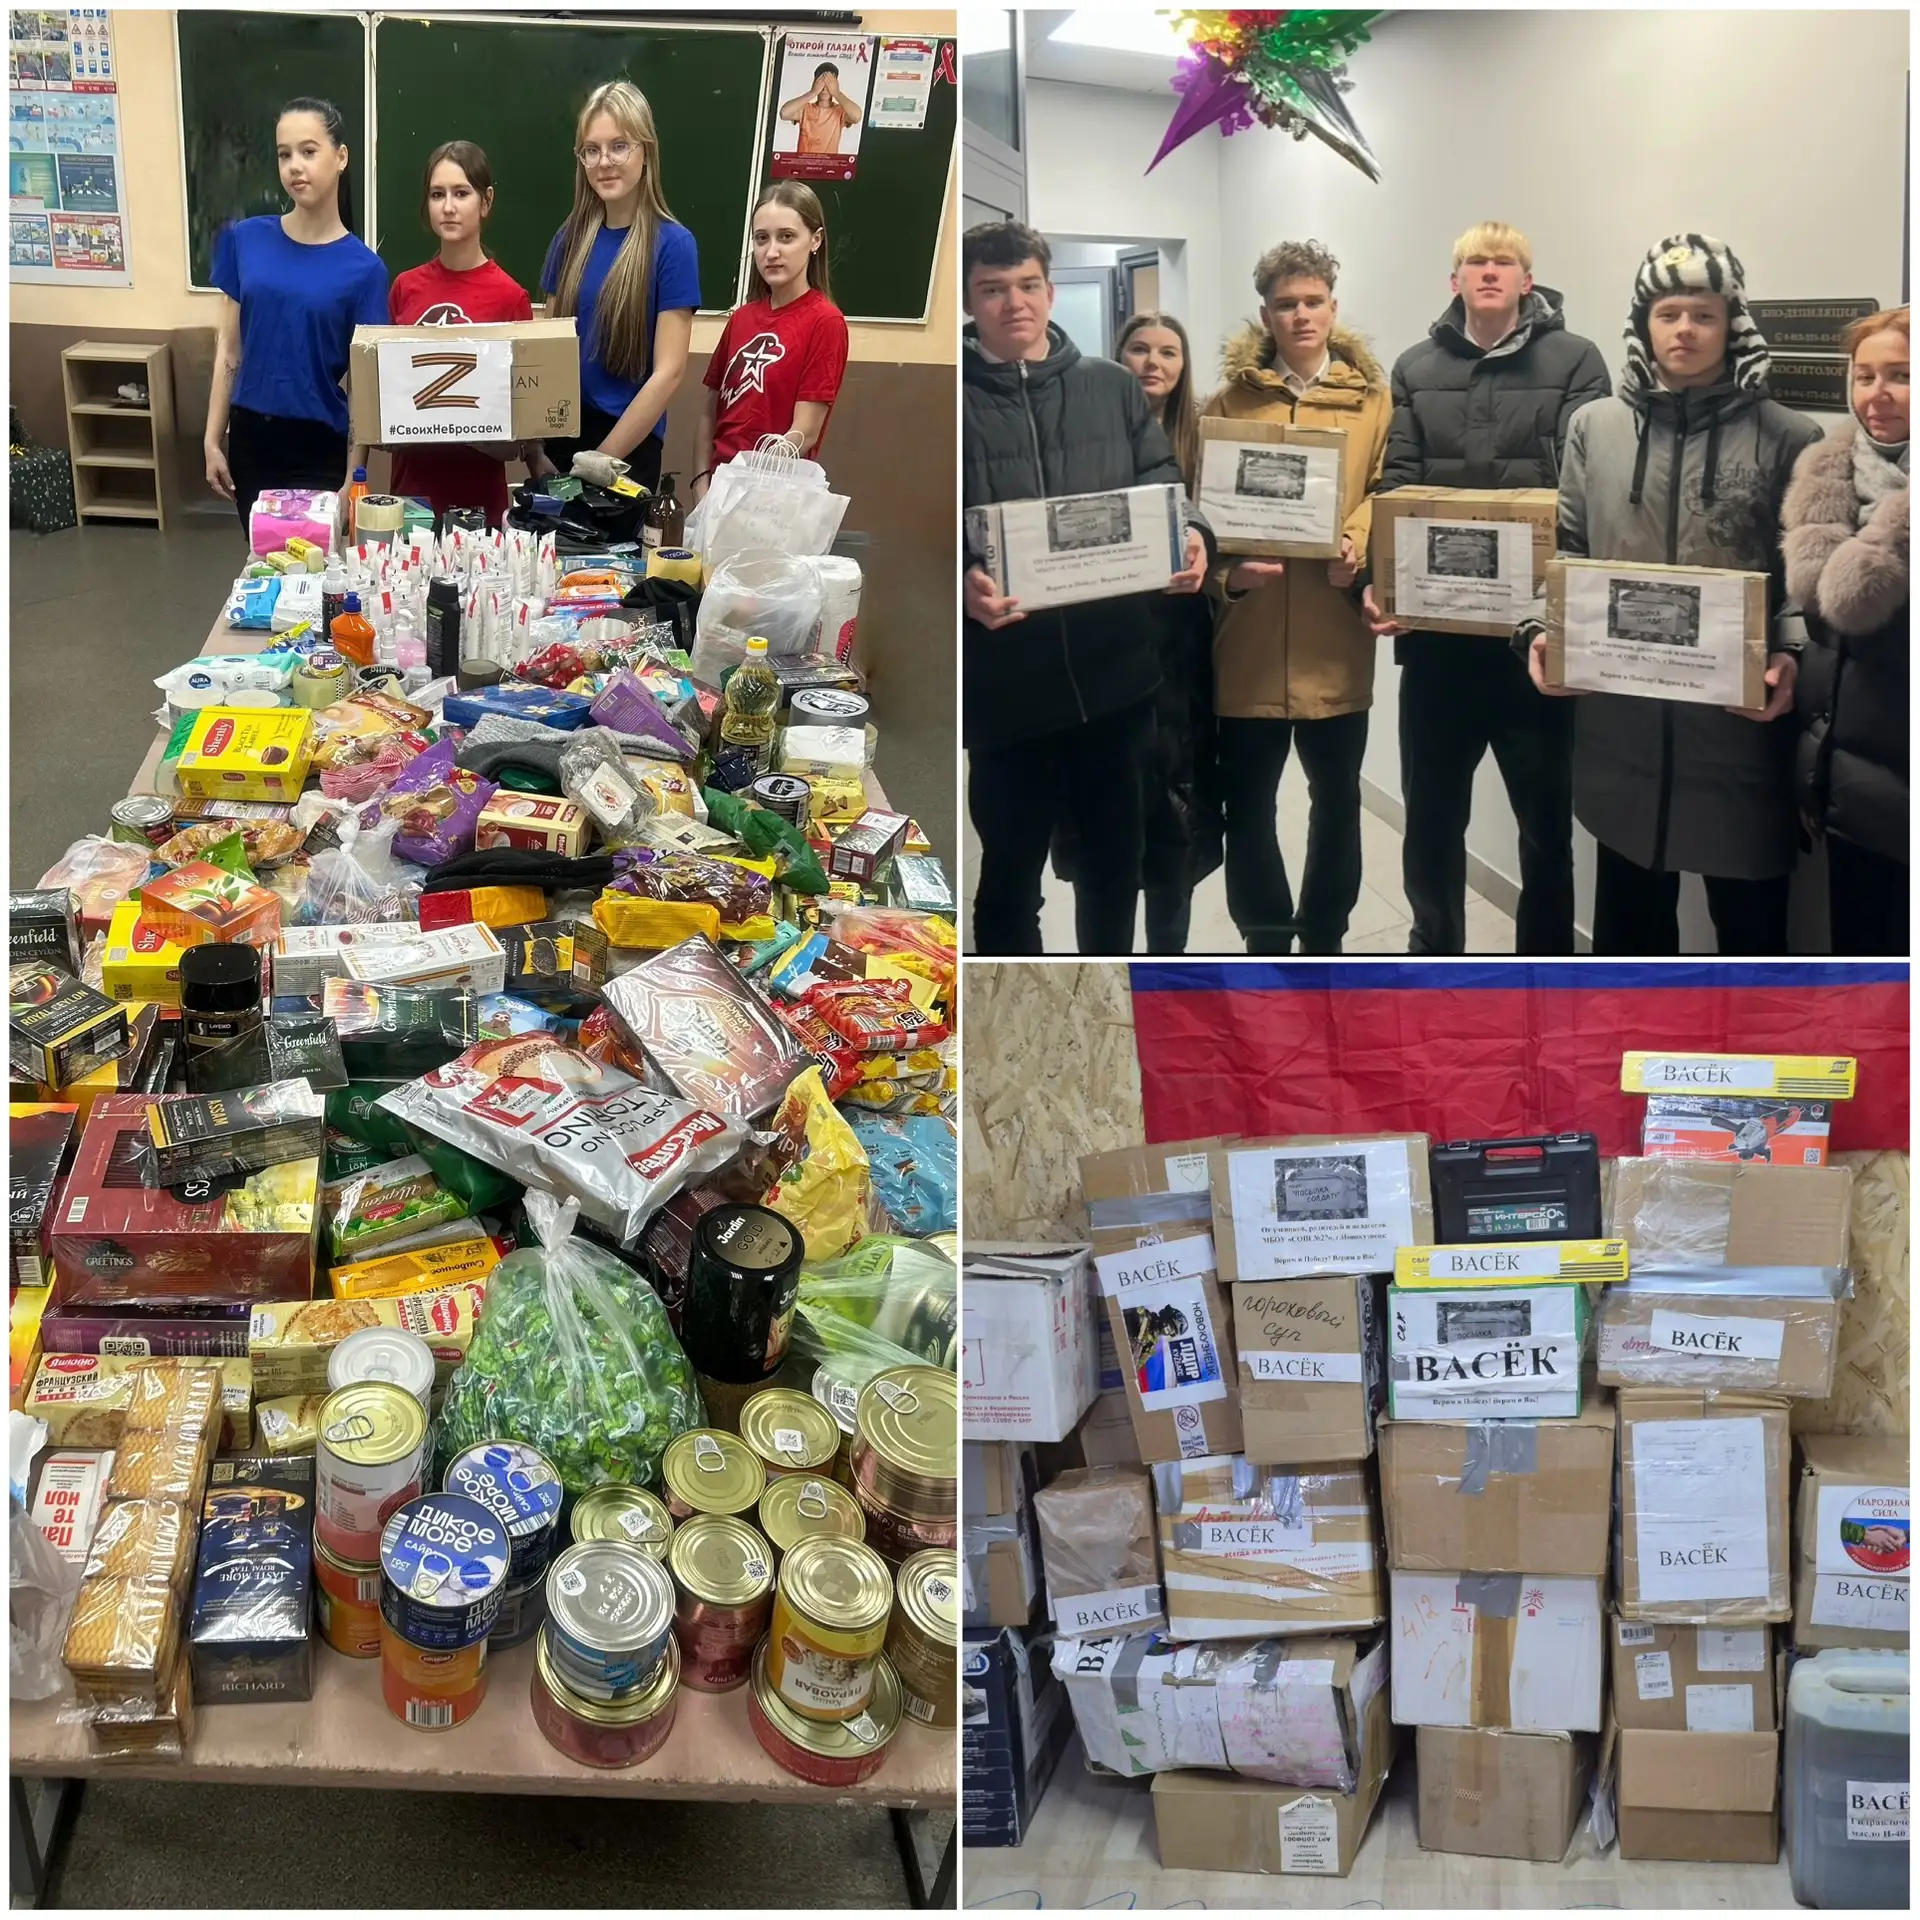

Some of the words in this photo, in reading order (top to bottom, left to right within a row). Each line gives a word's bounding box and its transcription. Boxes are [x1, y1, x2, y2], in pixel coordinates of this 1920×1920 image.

[789, 40, 825, 51] ОТКРОЙ
[827, 43, 856, 52] ГЛАЗА!
[1772, 365, 1845, 377] КОСМЕТОЛОГ
[411, 353, 480, 410] Z
[545, 416, 556, 424] 100
[389, 424, 503, 437] #СвоихНеБросаем
[205, 722, 232, 754] Shenly
[28, 948, 61, 956] CEYLON
[20, 1008, 55, 1027] ROYAL
[52, 989, 89, 1011] CEYLON
[382, 988, 397, 1032] Greenfield
[721, 995, 752, 1034] ХАРАКТЕ
[283, 1031, 327, 1051] Greenfield
[1664, 1064, 1733, 1083] ВАСЁК
[208, 1099, 230, 1127] ASSAM
[633, 1113, 721, 1173] MacCoffee
[1306, 1191, 1340, 1203] СОЛДАТУ"
[1494, 1209, 1564, 1221] ИНТЕРСКОЛ
[717, 1216, 746, 1244] Jardin
[737, 1223, 763, 1251] GOLD
[1261, 1226, 1271, 1234] От
[1263, 1235, 1284, 1244] МБОУ
[86, 1255, 134, 1267] GREETINGS
[431, 1259, 485, 1276] Сливочное
[1274, 1256, 1296, 1265] Верим
[1304, 1253, 1331, 1263] Победу!
[1333, 1254, 1355, 1262] Верим
[1362, 1252, 1377, 1260] Вас!
[1451, 1252, 1520, 1271] ВАСЁК
[1118, 1259, 1182, 1287] ВАСЁК
[1243, 1296, 1345, 1328] гороховый
[1192, 1302, 1217, 1376] НОВОКУЗНЕЦК
[1263, 1322, 1301, 1346] суп
[1671, 1330, 1742, 1352] ВАСЁК
[1180, 1341, 1200, 1379] ЛДПР
[1258, 1357, 1325, 1378] ВАСЁК
[1416, 1342, 1558, 1382] ВАСЁК
[36, 1372, 98, 1388] ФРАНЦУЗСКИЙ
[1433, 1398, 1456, 1407] Верим
[1524, 1396, 1539, 1404] Вас!
[1857, 1498, 1910, 1507] НАРОДНАЯ
[1872, 1508, 1898, 1517] СИЛА
[1211, 1525, 1275, 1544] ВАСЁК
[391, 1557, 411, 1568] ГОСТ
[1660, 1545, 1728, 1567] ВАСЁК
[219, 1572, 250, 1582] MORE
[1837, 1581, 1908, 1602] ВАСЁК
[1076, 1602, 1142, 1626] ВАСЁК
[221, 1682, 285, 1692] RICHARD
[795, 1681, 862, 1697] ПЕРЛОВАЯ
[812, 1695, 842, 1708] Каша
